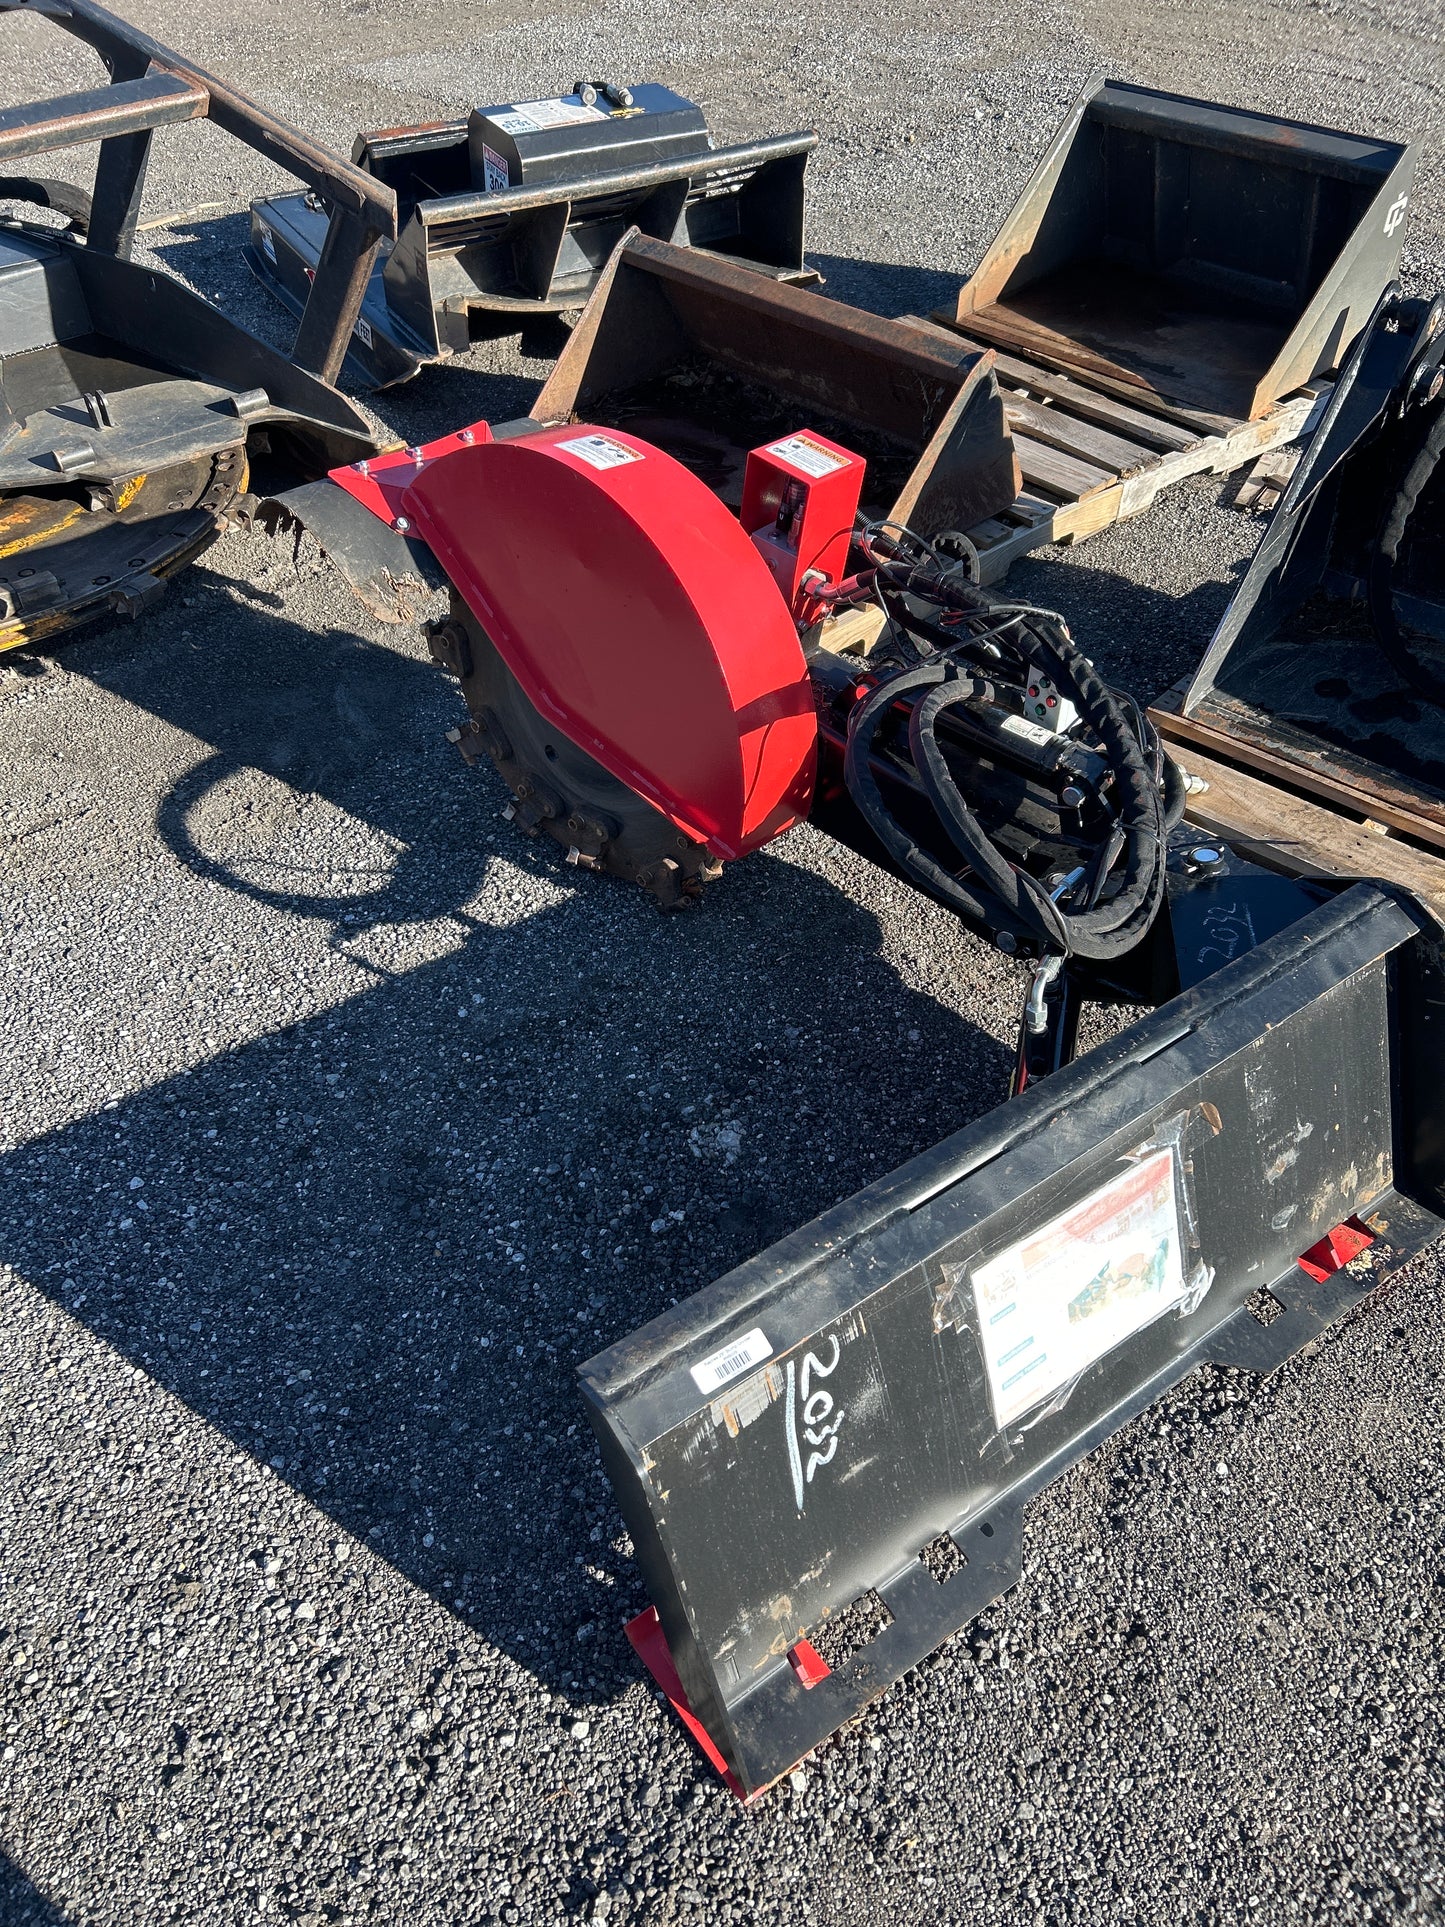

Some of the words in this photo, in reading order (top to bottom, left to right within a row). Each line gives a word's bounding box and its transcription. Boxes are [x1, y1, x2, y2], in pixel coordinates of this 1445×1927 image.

[806, 439, 845, 463] WARNING
[1197, 902, 1248, 963] 2032
[801, 1333, 845, 1483] 2032
